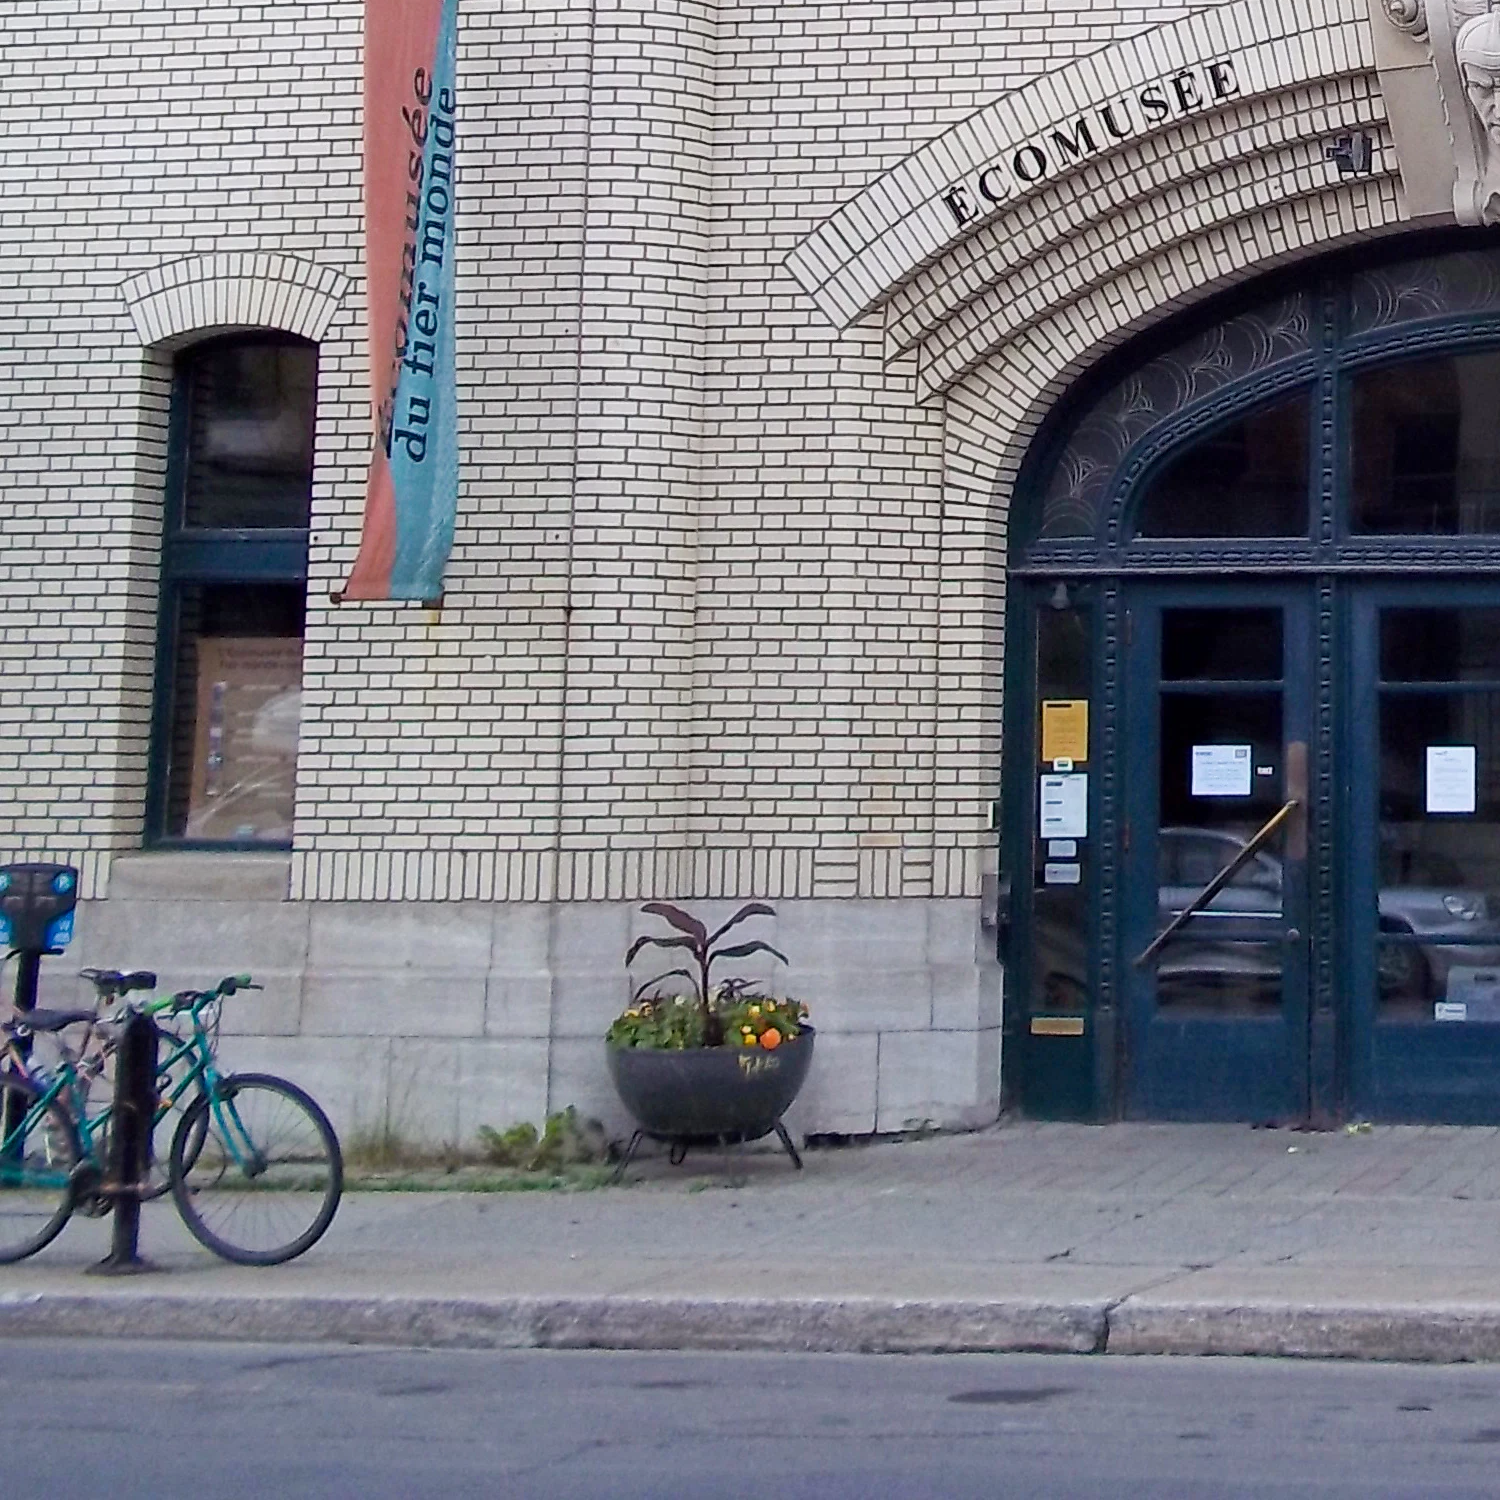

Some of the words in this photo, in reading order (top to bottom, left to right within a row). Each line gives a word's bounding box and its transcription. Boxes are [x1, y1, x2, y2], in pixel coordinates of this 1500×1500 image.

[422, 87, 456, 269] monde
[941, 59, 1242, 229] ÉCOMUSÉE
[403, 281, 440, 379] fier
[395, 396, 431, 463] du
